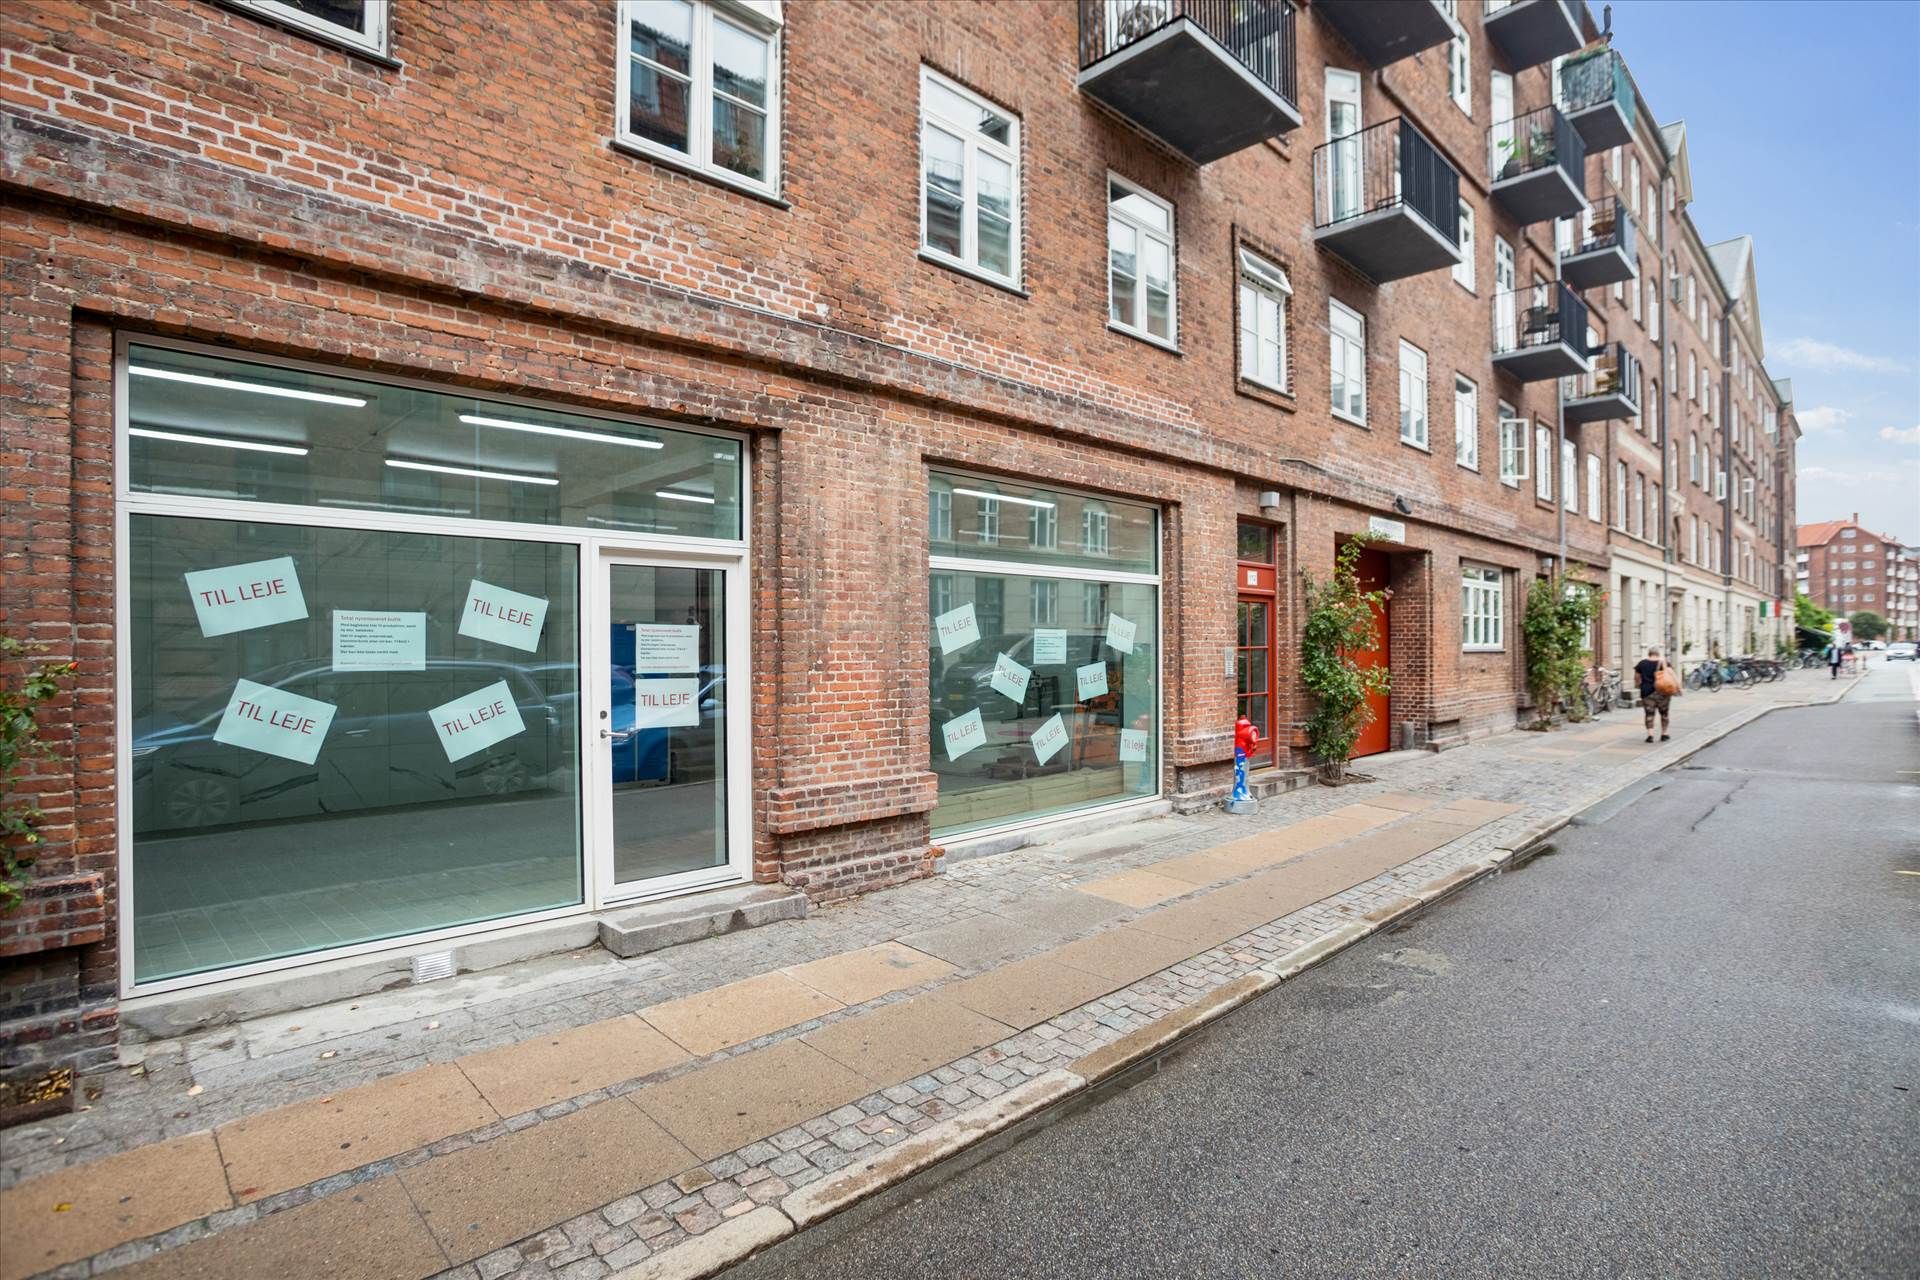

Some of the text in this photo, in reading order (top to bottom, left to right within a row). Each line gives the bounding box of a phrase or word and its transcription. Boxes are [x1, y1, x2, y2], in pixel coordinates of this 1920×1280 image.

[200, 579, 287, 607] TIL LEJE
[473, 598, 534, 627] TIL LEJE
[953, 617, 972, 632] LEJE
[641, 693, 690, 707] TIL LEJE
[238, 701, 316, 735] TIL LEJE
[442, 700, 507, 736] TIL LEJE
